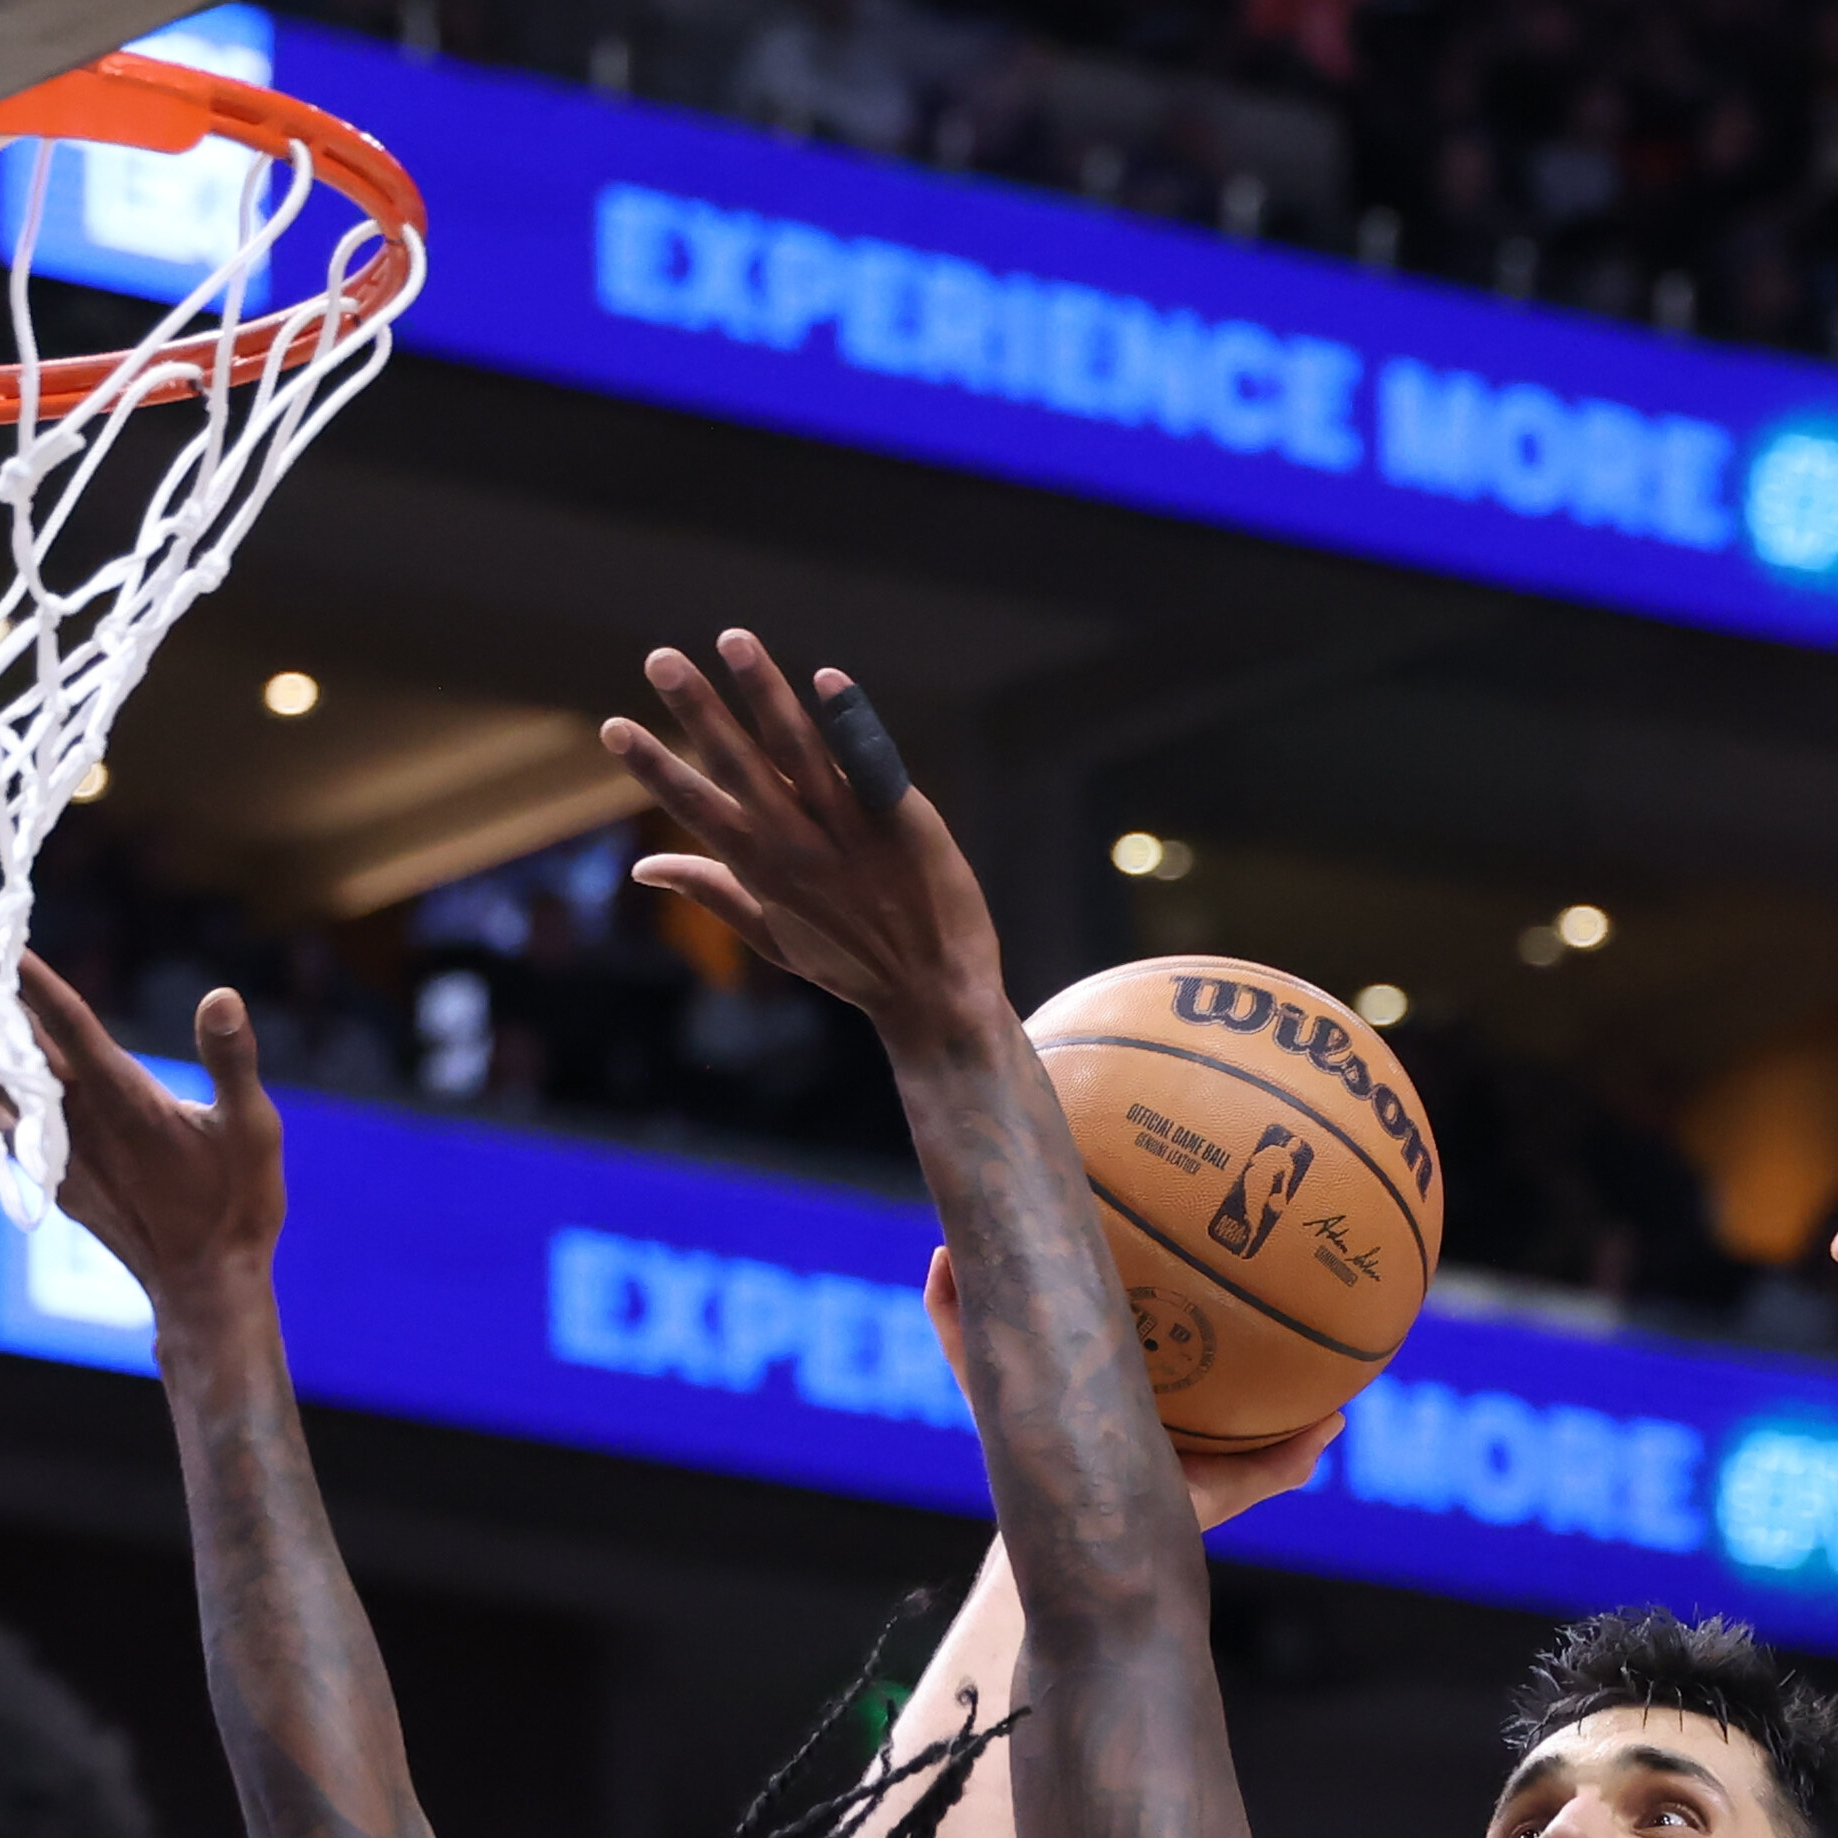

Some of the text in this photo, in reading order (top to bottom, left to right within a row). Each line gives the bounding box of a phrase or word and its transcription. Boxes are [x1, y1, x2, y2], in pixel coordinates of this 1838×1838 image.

[594, 180, 1362, 472] EXPERIENCE
[1375, 356, 1734, 552] MORE
[1126, 1103, 1231, 1171] OFFICIAL GAME BALL
[1169, 974, 1434, 1204] Wilson
[1134, 1132, 1201, 1176] GENUINE LEATHER
[1215, 1215, 1247, 1244] NBA
[1345, 1370, 1707, 1558] MORE
